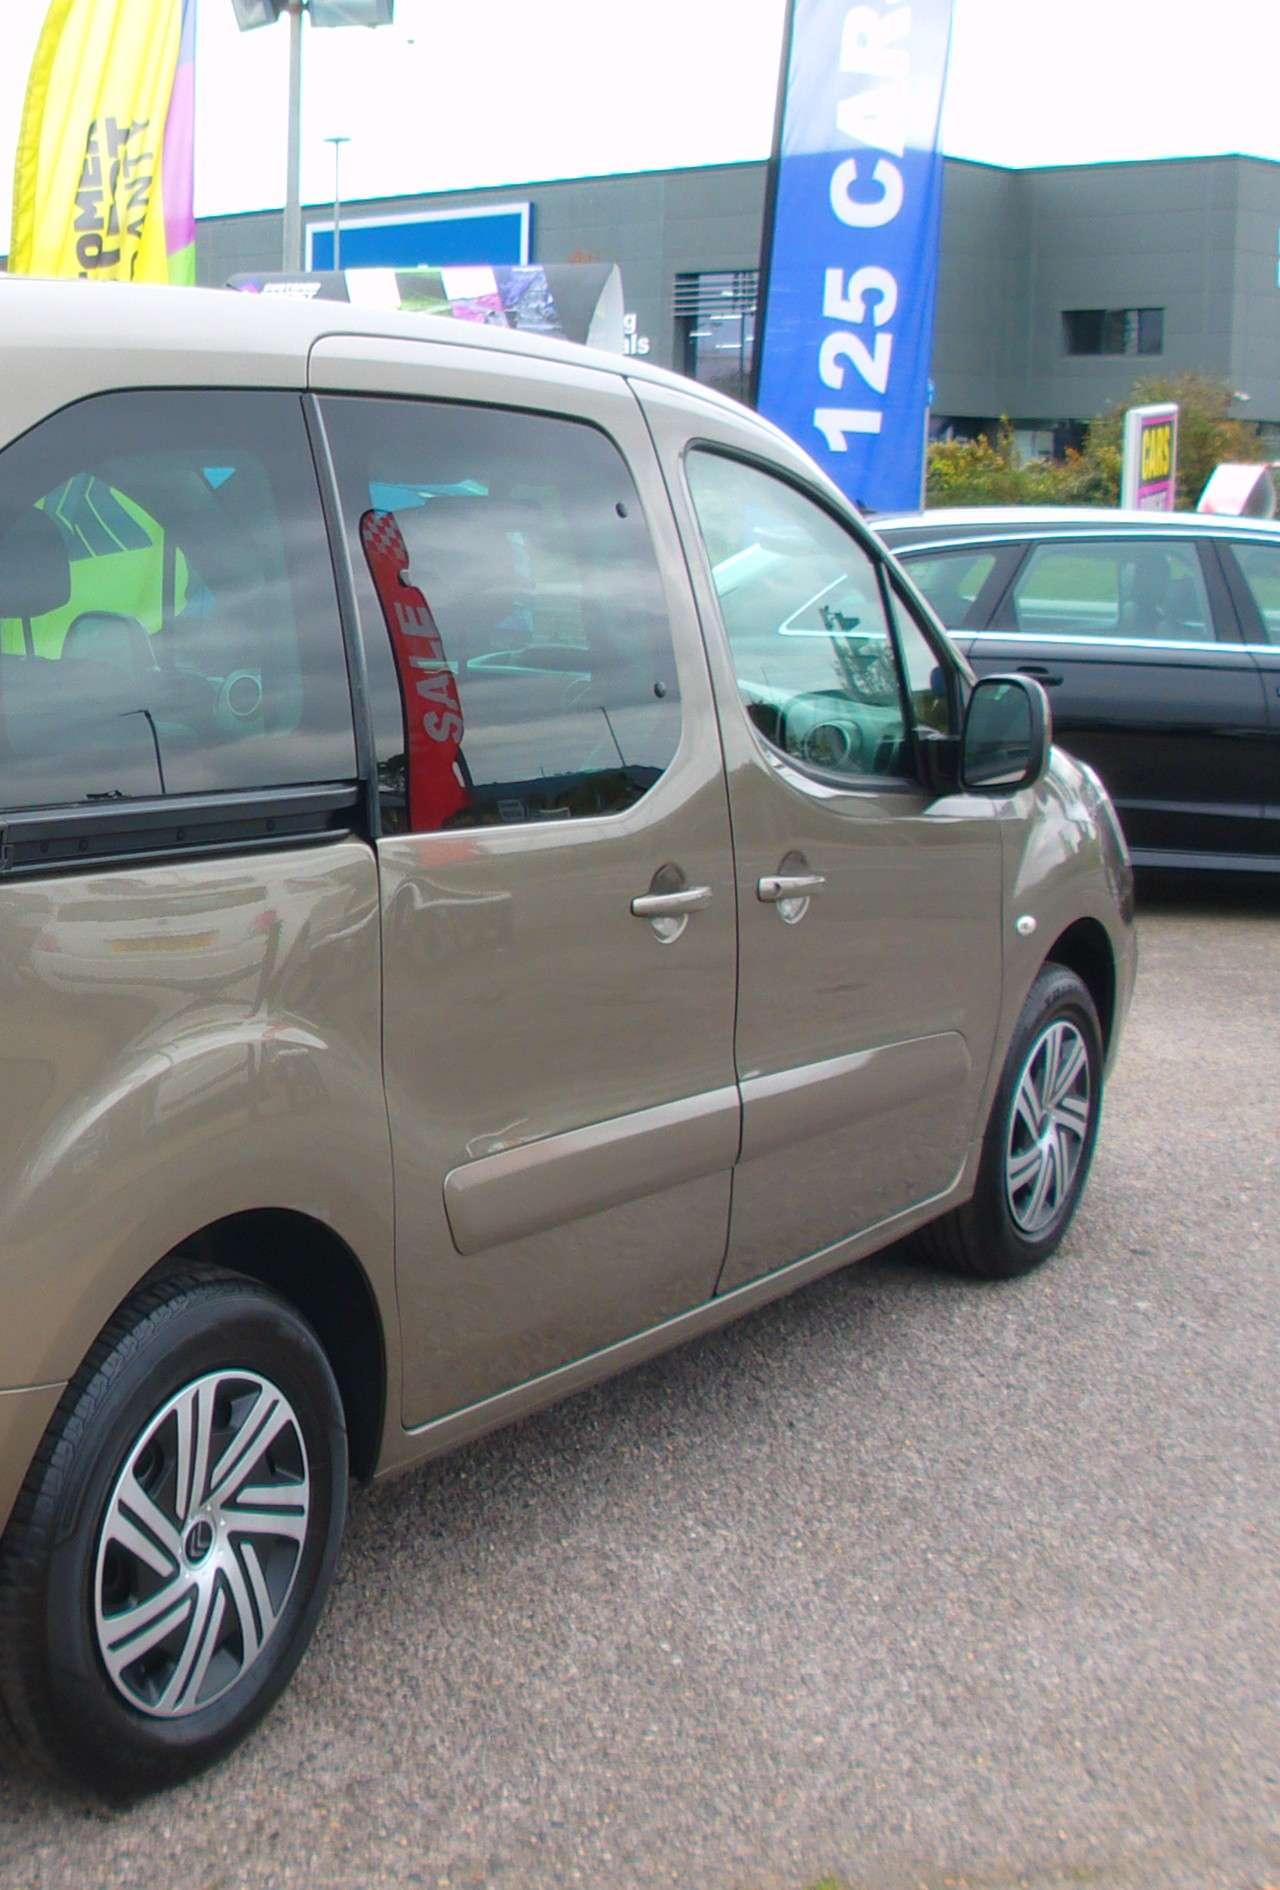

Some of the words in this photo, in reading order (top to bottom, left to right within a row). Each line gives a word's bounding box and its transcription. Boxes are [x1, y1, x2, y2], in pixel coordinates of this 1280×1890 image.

[829, 0, 912, 229] CAR
[814, 265, 898, 452] 125
[1142, 425, 1170, 481] CARS
[395, 602, 464, 746] SALE
